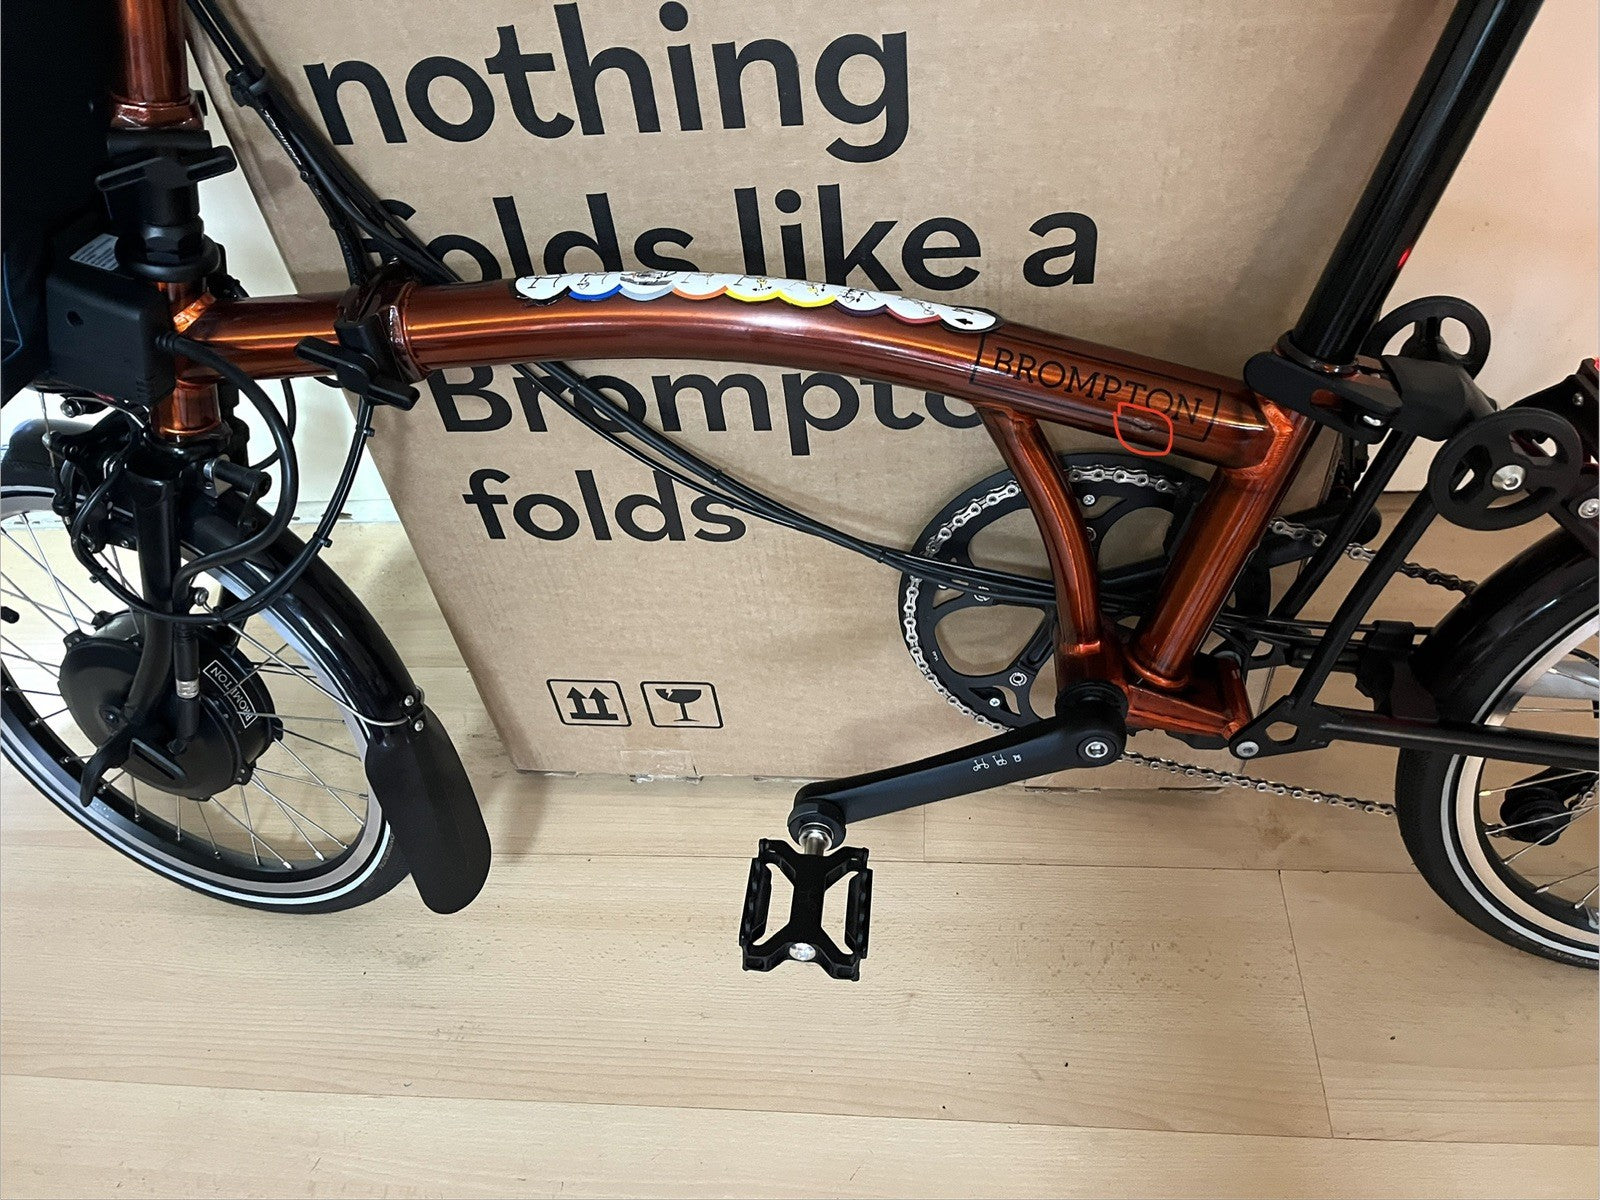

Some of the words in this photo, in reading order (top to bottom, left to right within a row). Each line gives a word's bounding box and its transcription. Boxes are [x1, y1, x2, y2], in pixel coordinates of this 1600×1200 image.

[303, 2, 909, 163] nothing
[734, 184, 981, 290] like
[1022, 212, 1098, 287] a
[991, 346, 1203, 425] BROMPTON
[463, 468, 746, 542] folds
